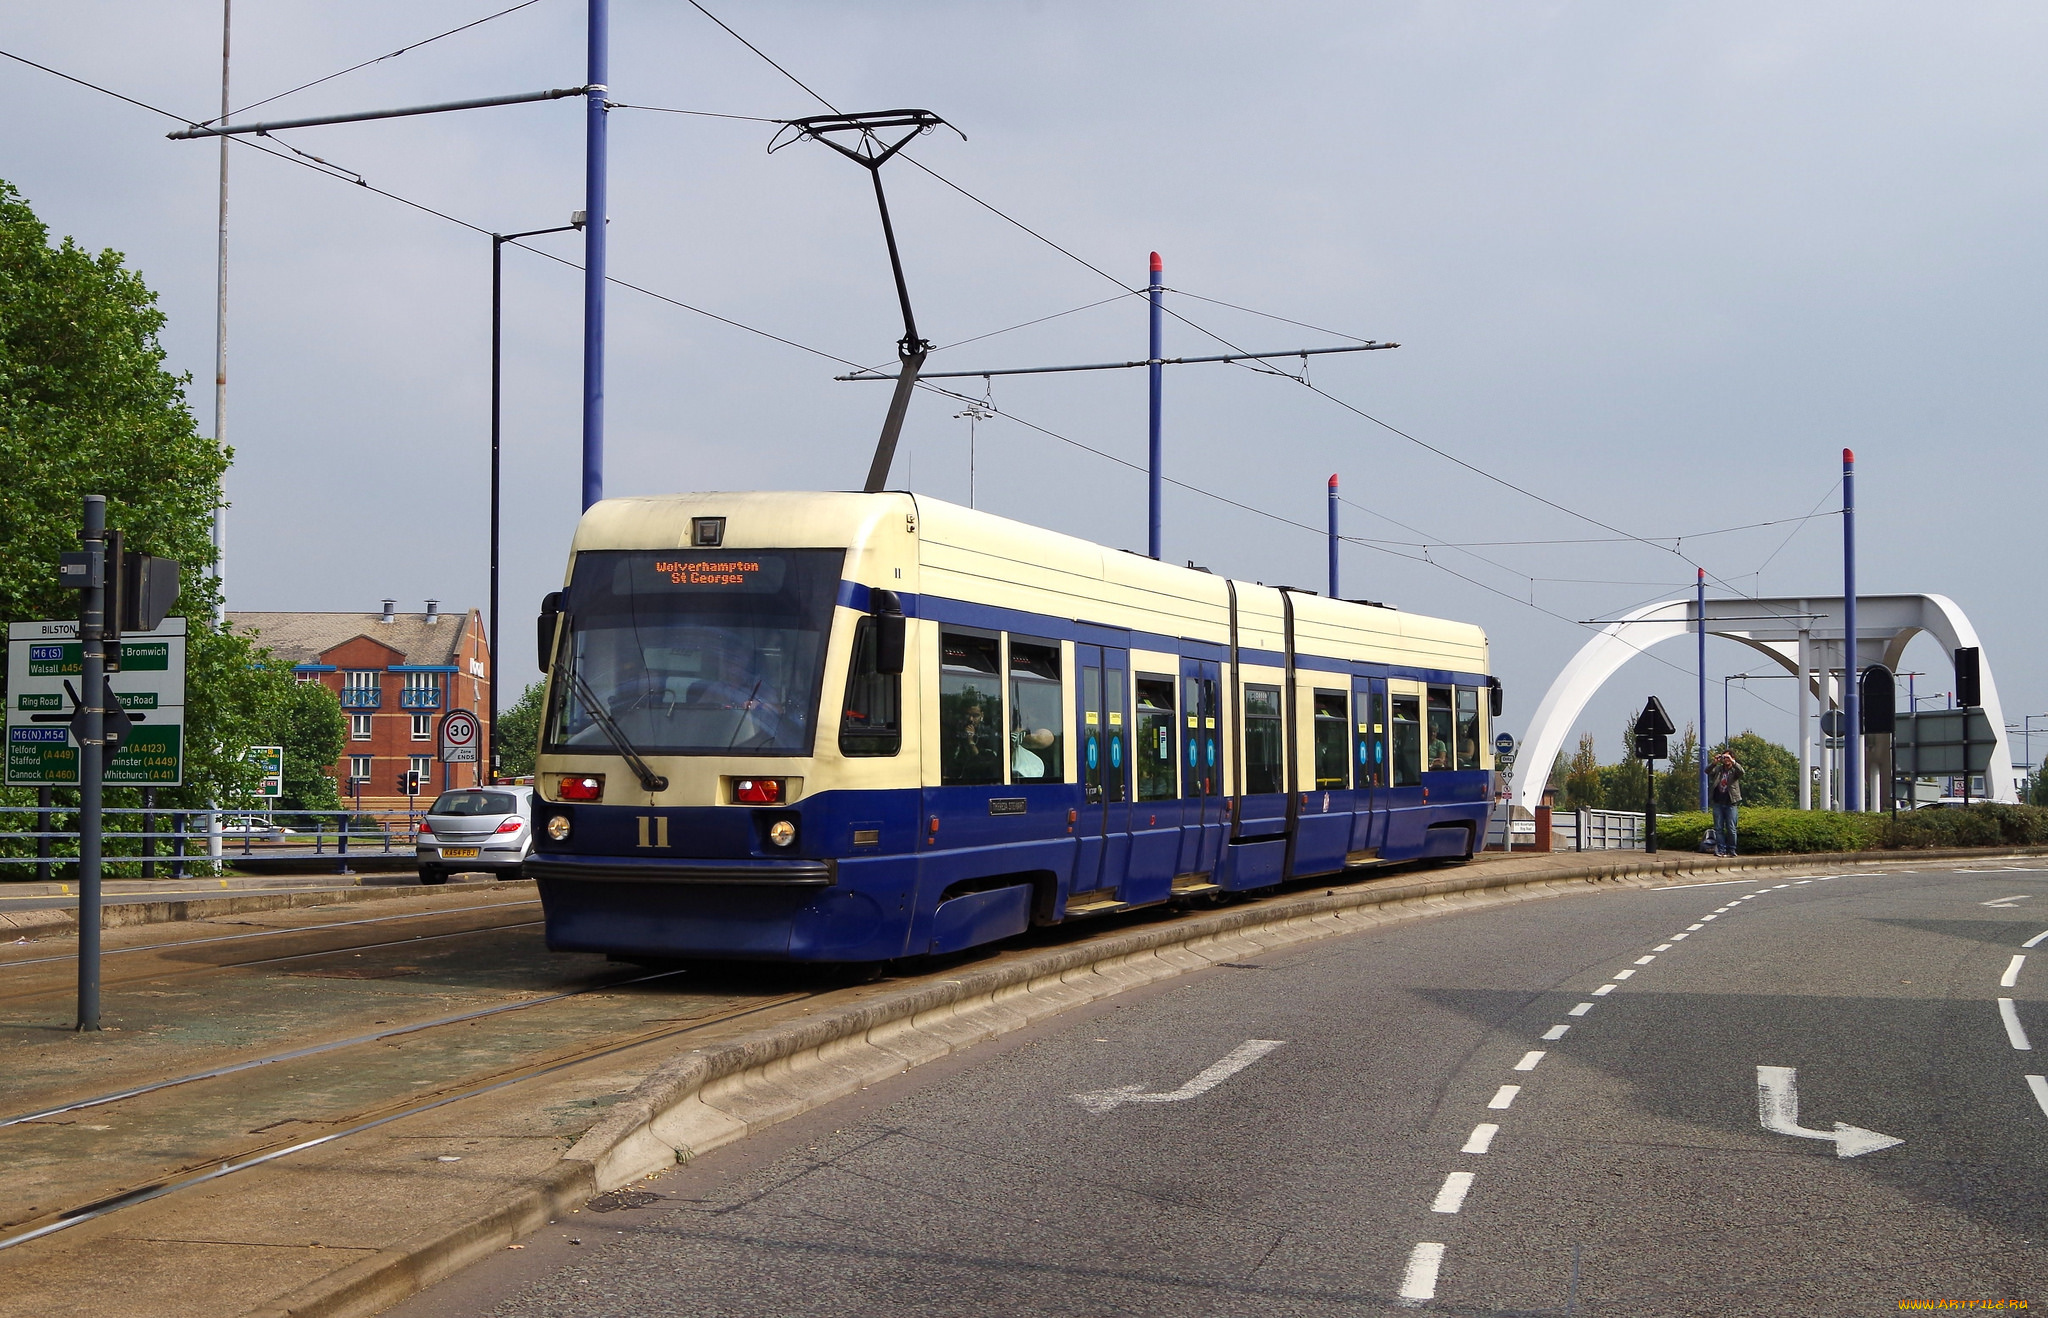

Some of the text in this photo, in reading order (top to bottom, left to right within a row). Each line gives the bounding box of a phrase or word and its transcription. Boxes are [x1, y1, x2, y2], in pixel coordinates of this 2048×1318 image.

[656, 561, 759, 572] Wolverhampton
[671, 572, 743, 584] St Georges
[42, 625, 76, 634] BILSTON
[126, 647, 167, 656] Bromwich
[30, 664, 59, 673] Walsall
[22, 697, 59, 707] Ring Road
[133, 696, 154, 704] Road
[450, 724, 470, 736] 30
[10, 745, 37, 754] Telford
[10, 756, 41, 765] Stafford
[111, 757, 141, 766] minster
[9, 769, 41, 779] Cannock
[635, 816, 672, 848] 11
